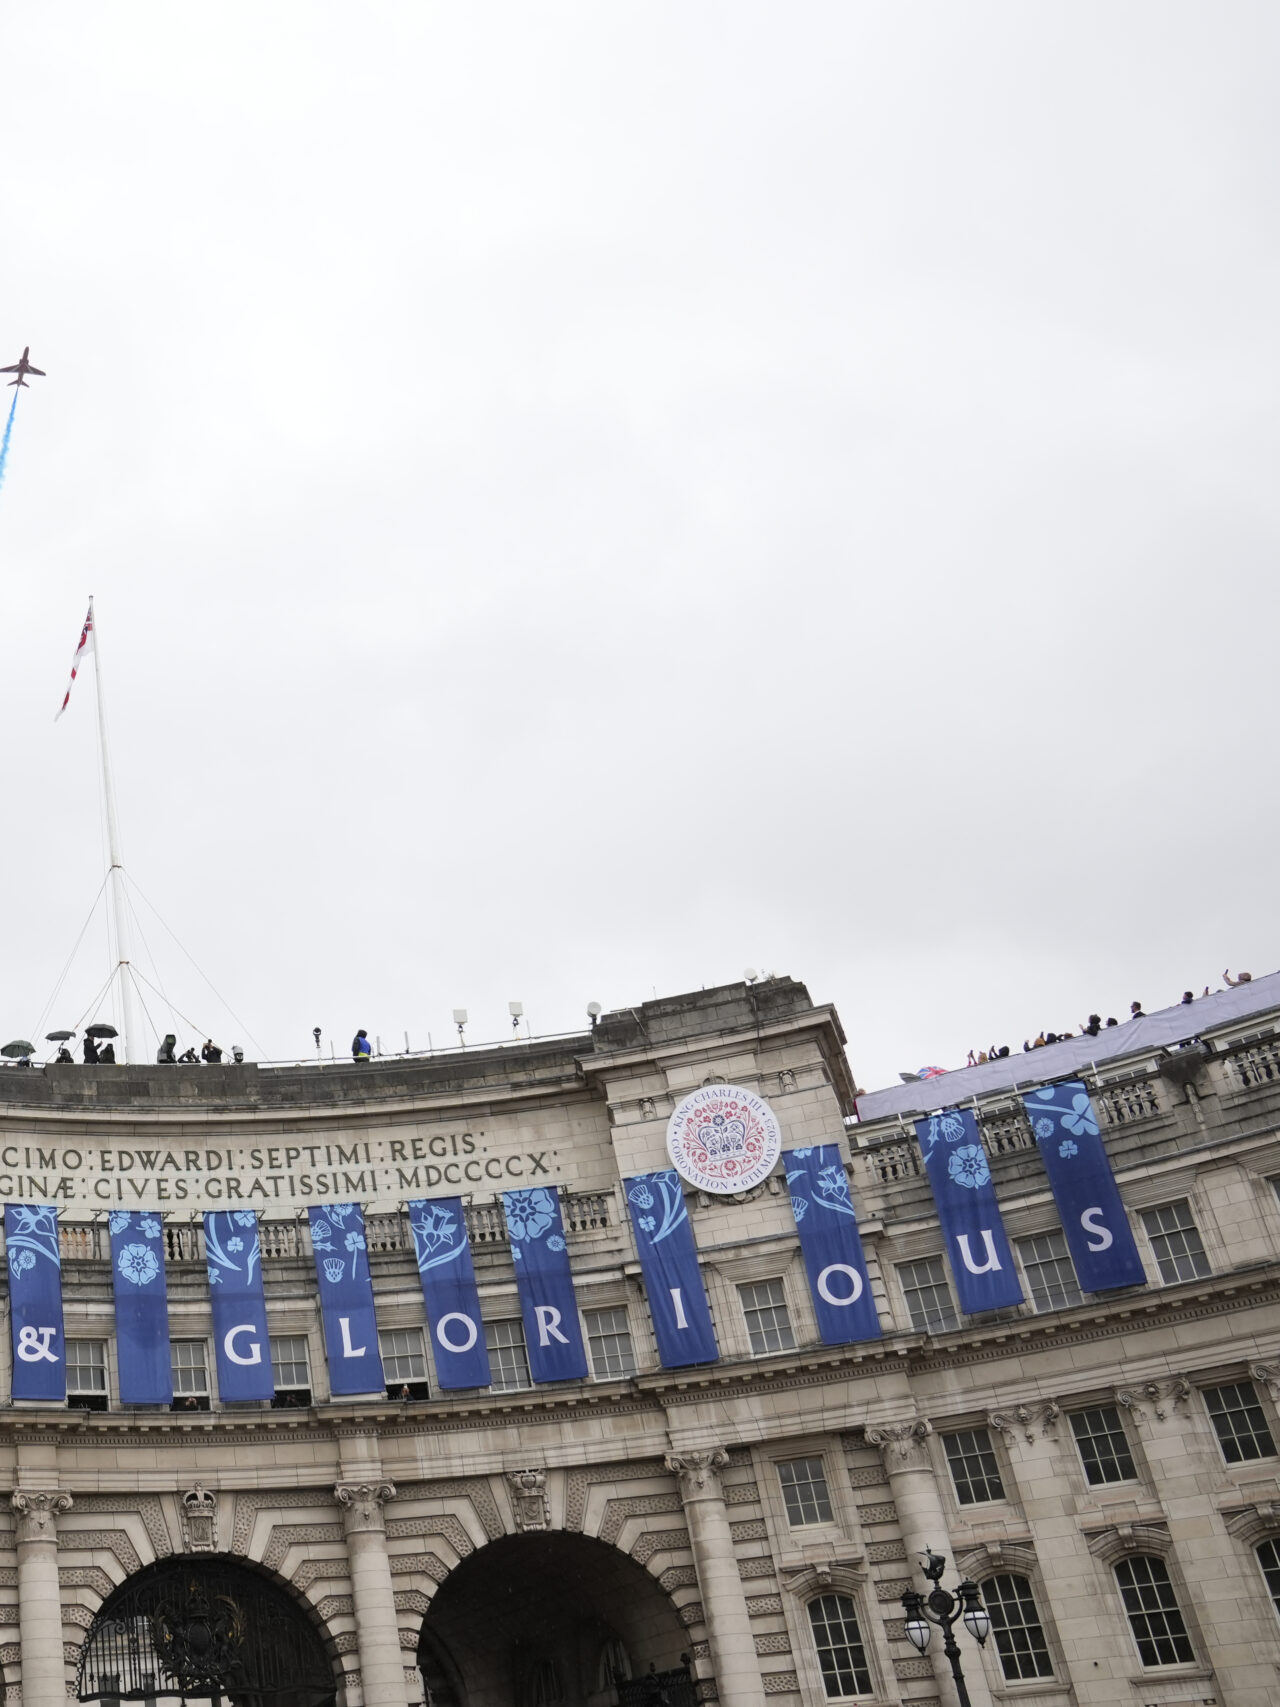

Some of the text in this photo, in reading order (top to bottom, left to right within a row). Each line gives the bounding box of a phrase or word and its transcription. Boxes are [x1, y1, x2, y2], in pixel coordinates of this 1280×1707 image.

[673, 1089, 763, 1128] KING CHARLES III
[765, 1118, 778, 1145] 2023
[100, 1149, 234, 1172] EDWARDI
[250, 1142, 371, 1169] SEPTIMI
[390, 1132, 476, 1163] REGIS
[670, 1138, 729, 1191] CORONATION
[760, 1148, 777, 1173] MAY
[94, 1177, 189, 1200] CIVES
[204, 1169, 378, 1200] GRATISSIMI
[398, 1152, 550, 1189] MDCCCCX
[17, 1326, 60, 1363] &
